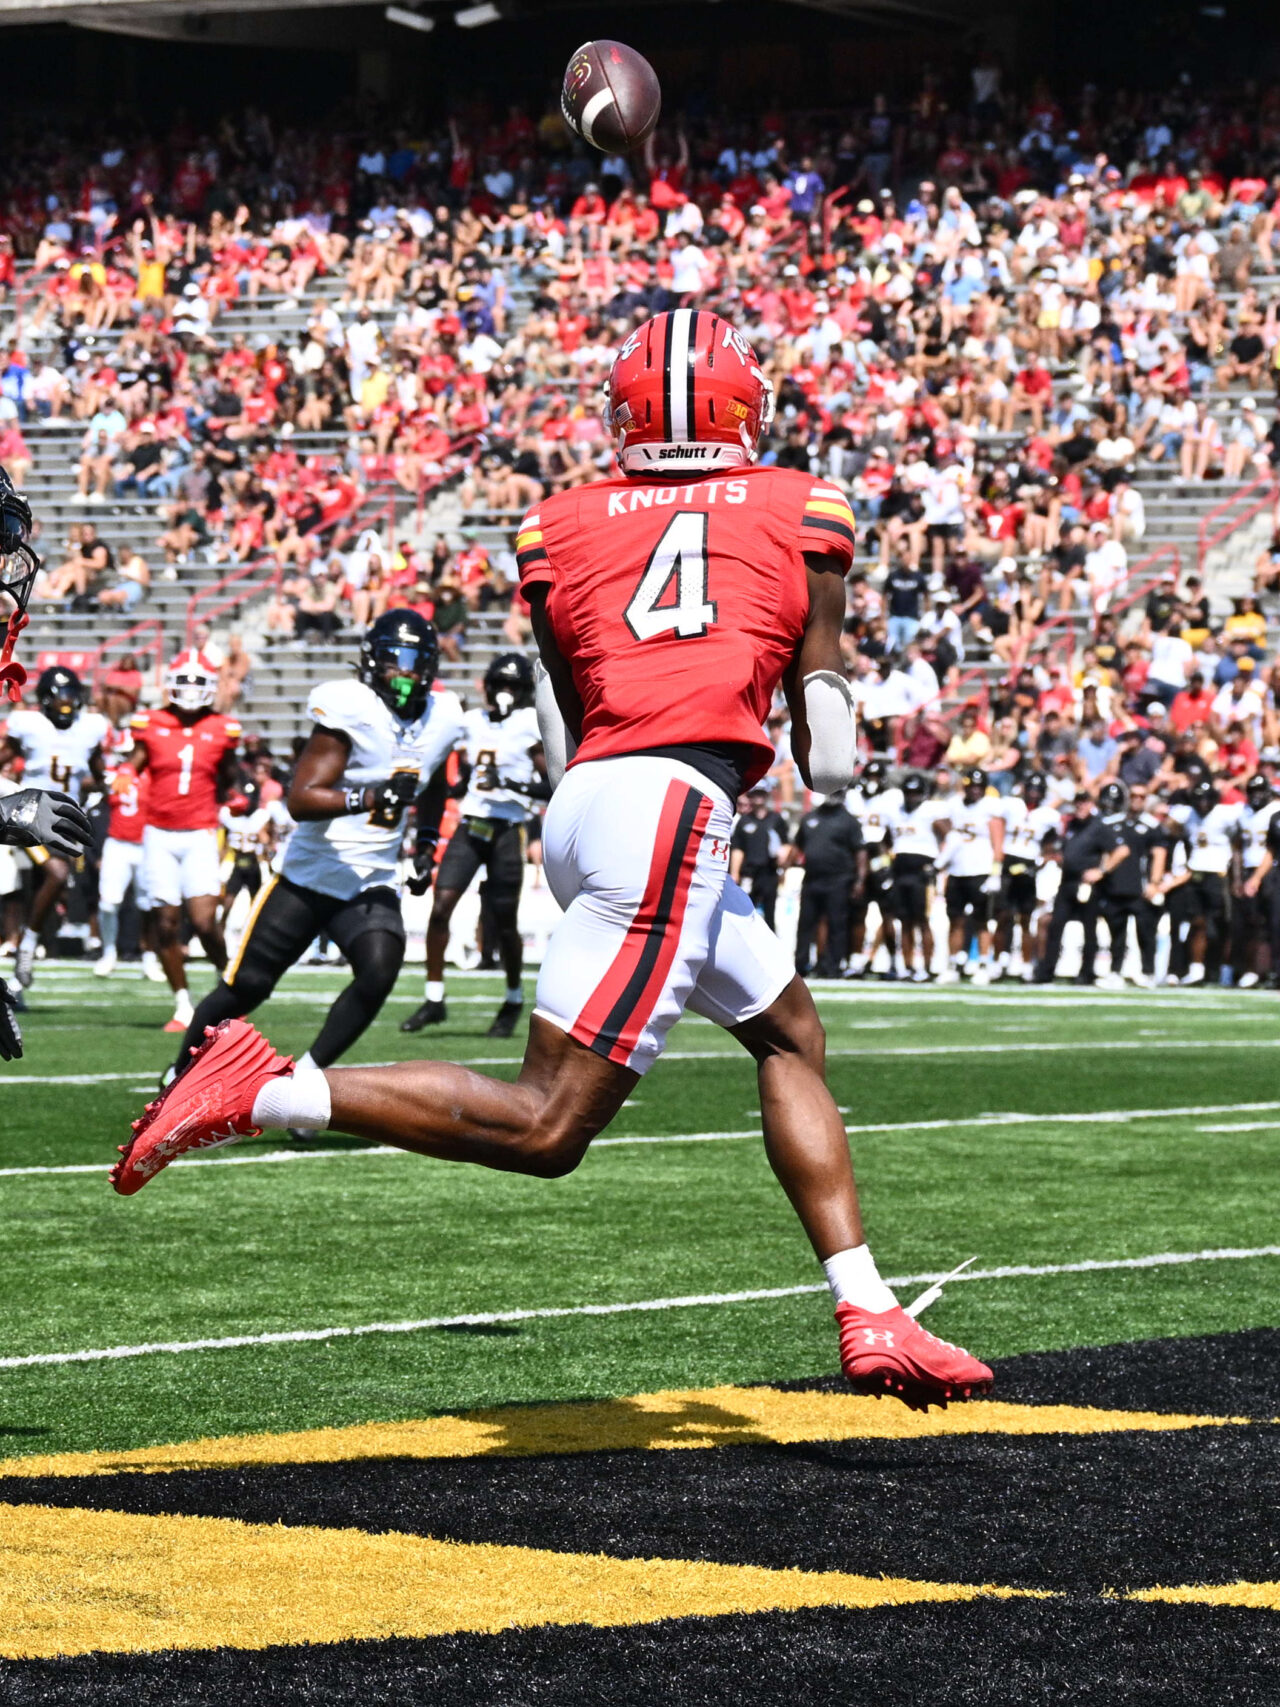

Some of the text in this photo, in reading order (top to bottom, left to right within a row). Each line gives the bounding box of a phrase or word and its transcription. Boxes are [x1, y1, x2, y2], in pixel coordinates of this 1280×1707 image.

[658, 445, 708, 460] schutt
[608, 479, 749, 517] KNOTTS
[623, 510, 718, 640] 4
[50, 755, 72, 793] 4
[177, 743, 194, 795] 1
